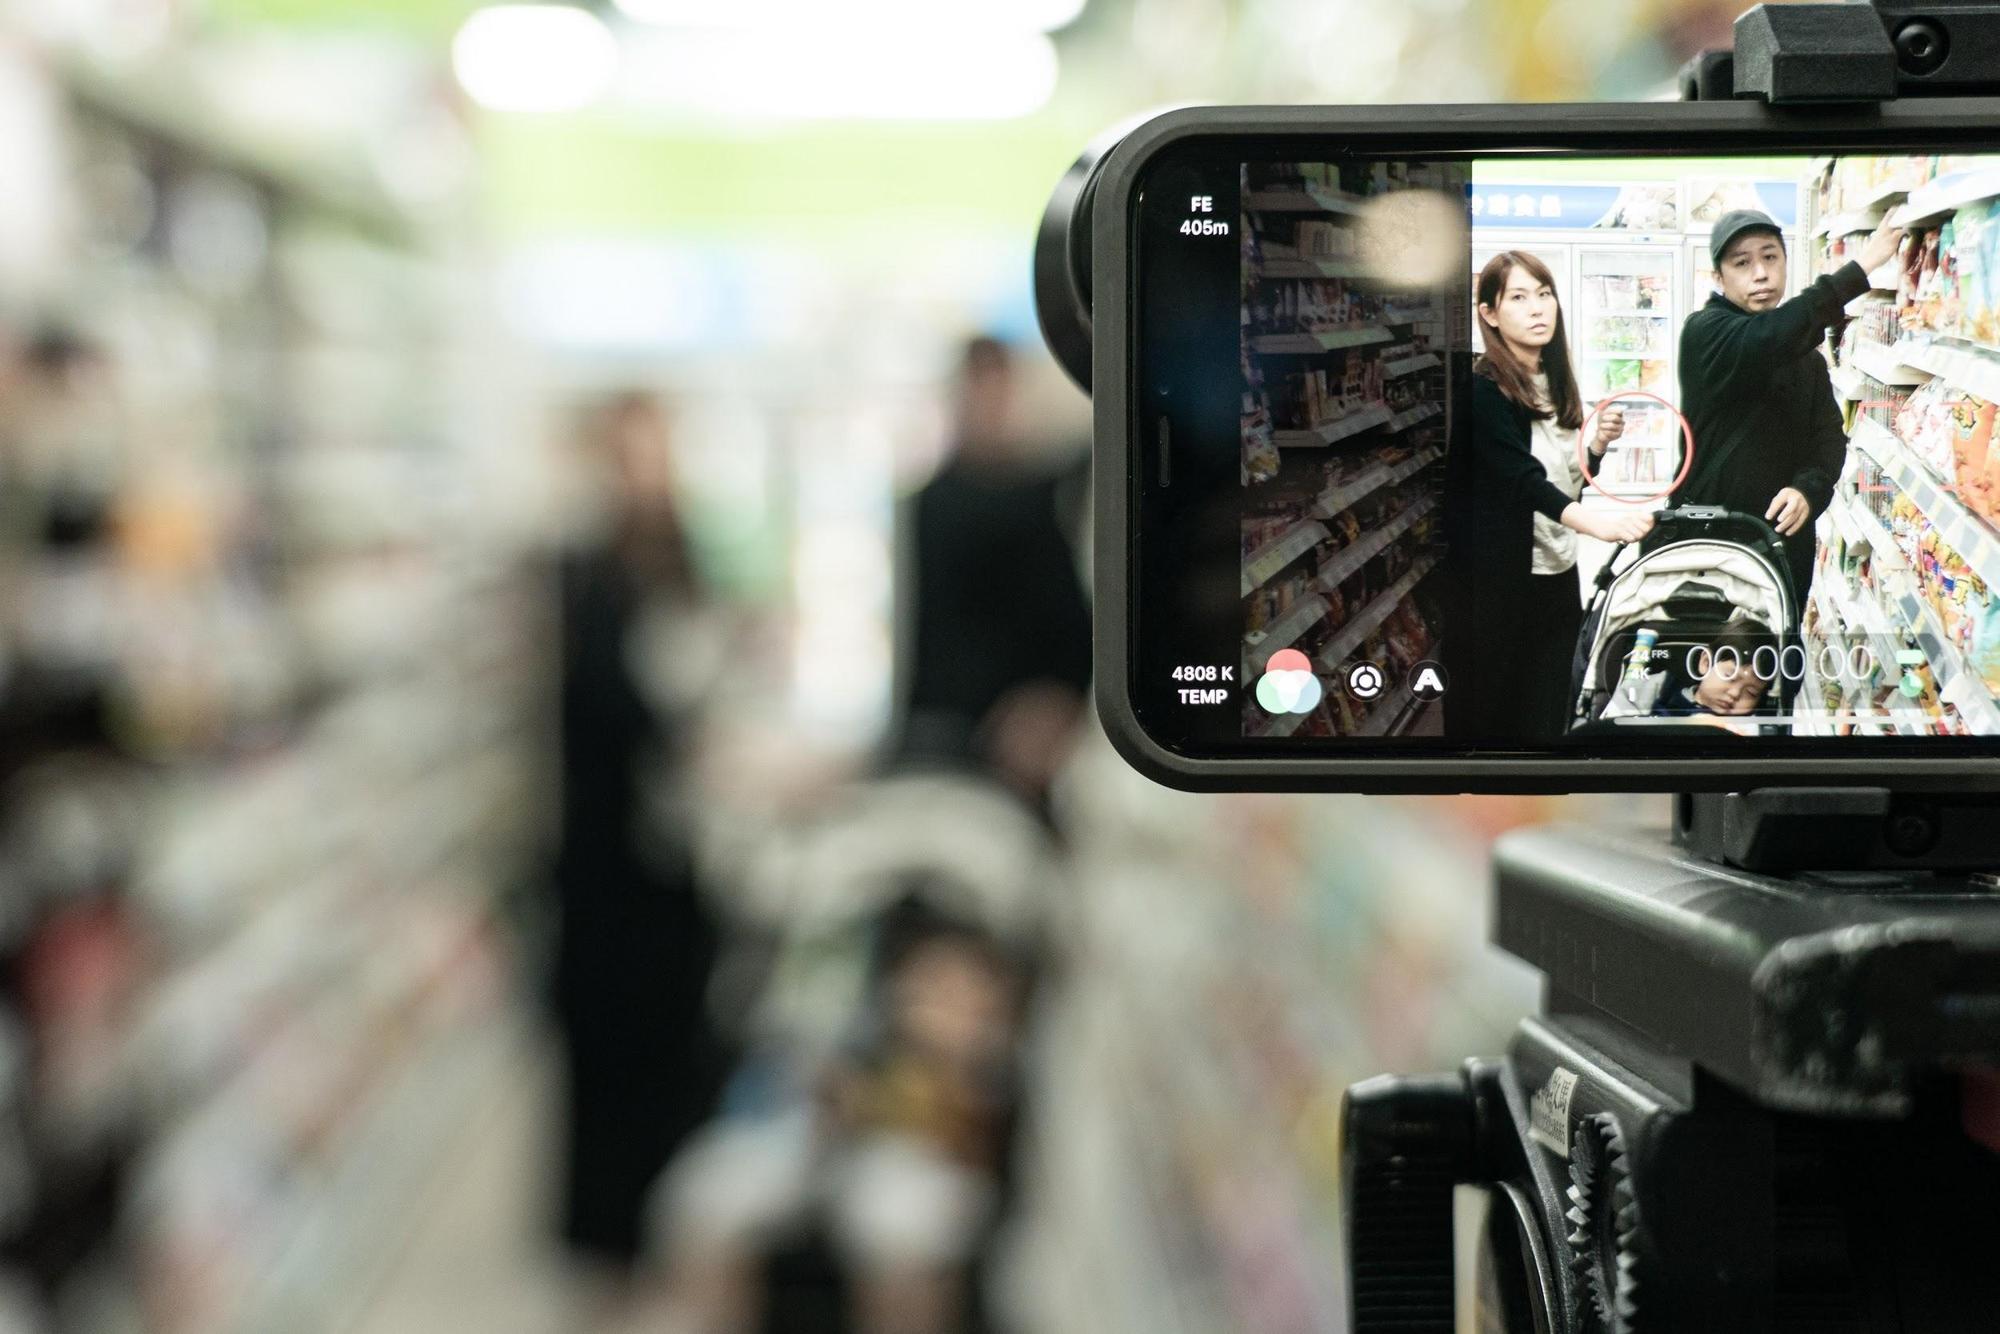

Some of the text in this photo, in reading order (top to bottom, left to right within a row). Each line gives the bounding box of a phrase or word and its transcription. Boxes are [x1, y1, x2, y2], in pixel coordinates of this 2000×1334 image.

[1191, 196, 1213, 213] FE
[1180, 219, 1229, 236] 405m
[1651, 649, 1670, 660] FPS
[1171, 665, 1234, 682] 4808 K
[1177, 688, 1228, 705] TEMP
